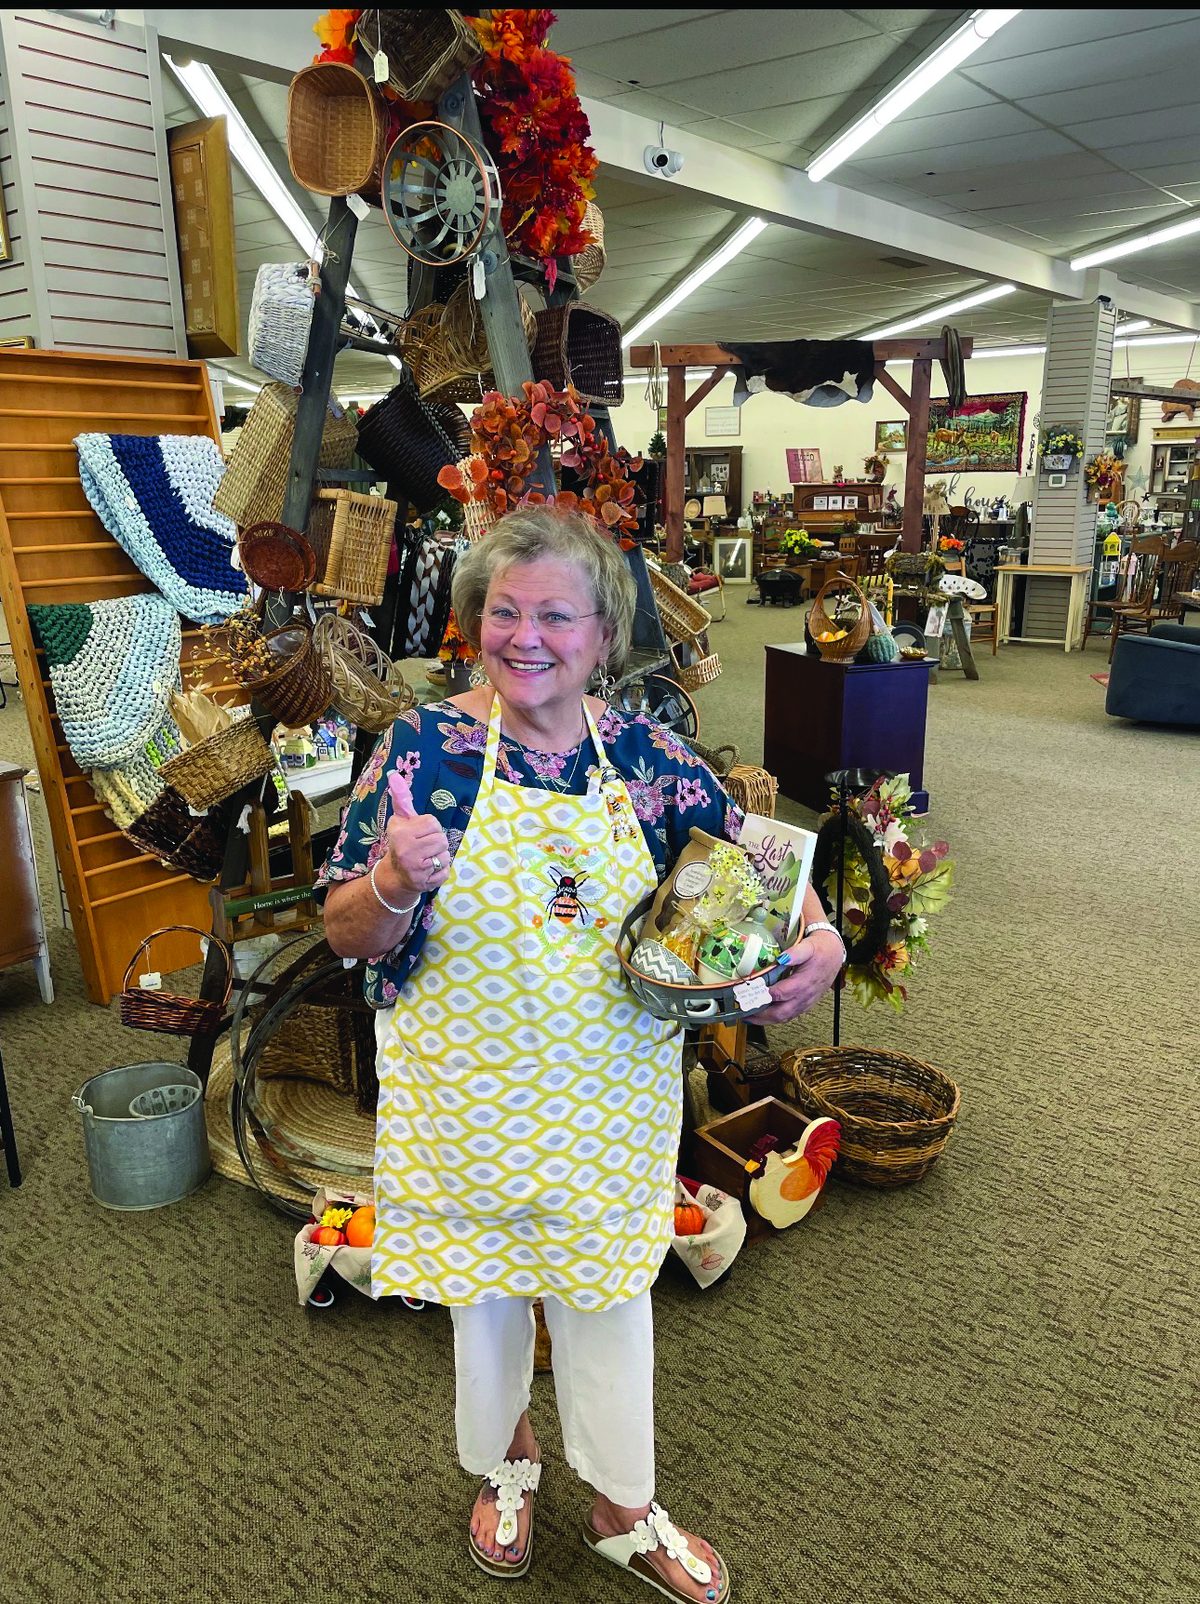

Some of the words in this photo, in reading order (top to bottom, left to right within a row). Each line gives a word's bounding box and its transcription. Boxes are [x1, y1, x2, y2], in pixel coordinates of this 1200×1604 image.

[748, 840, 760, 850] THE
[754, 835, 793, 871] Last
[282, 896, 300, 904] where
